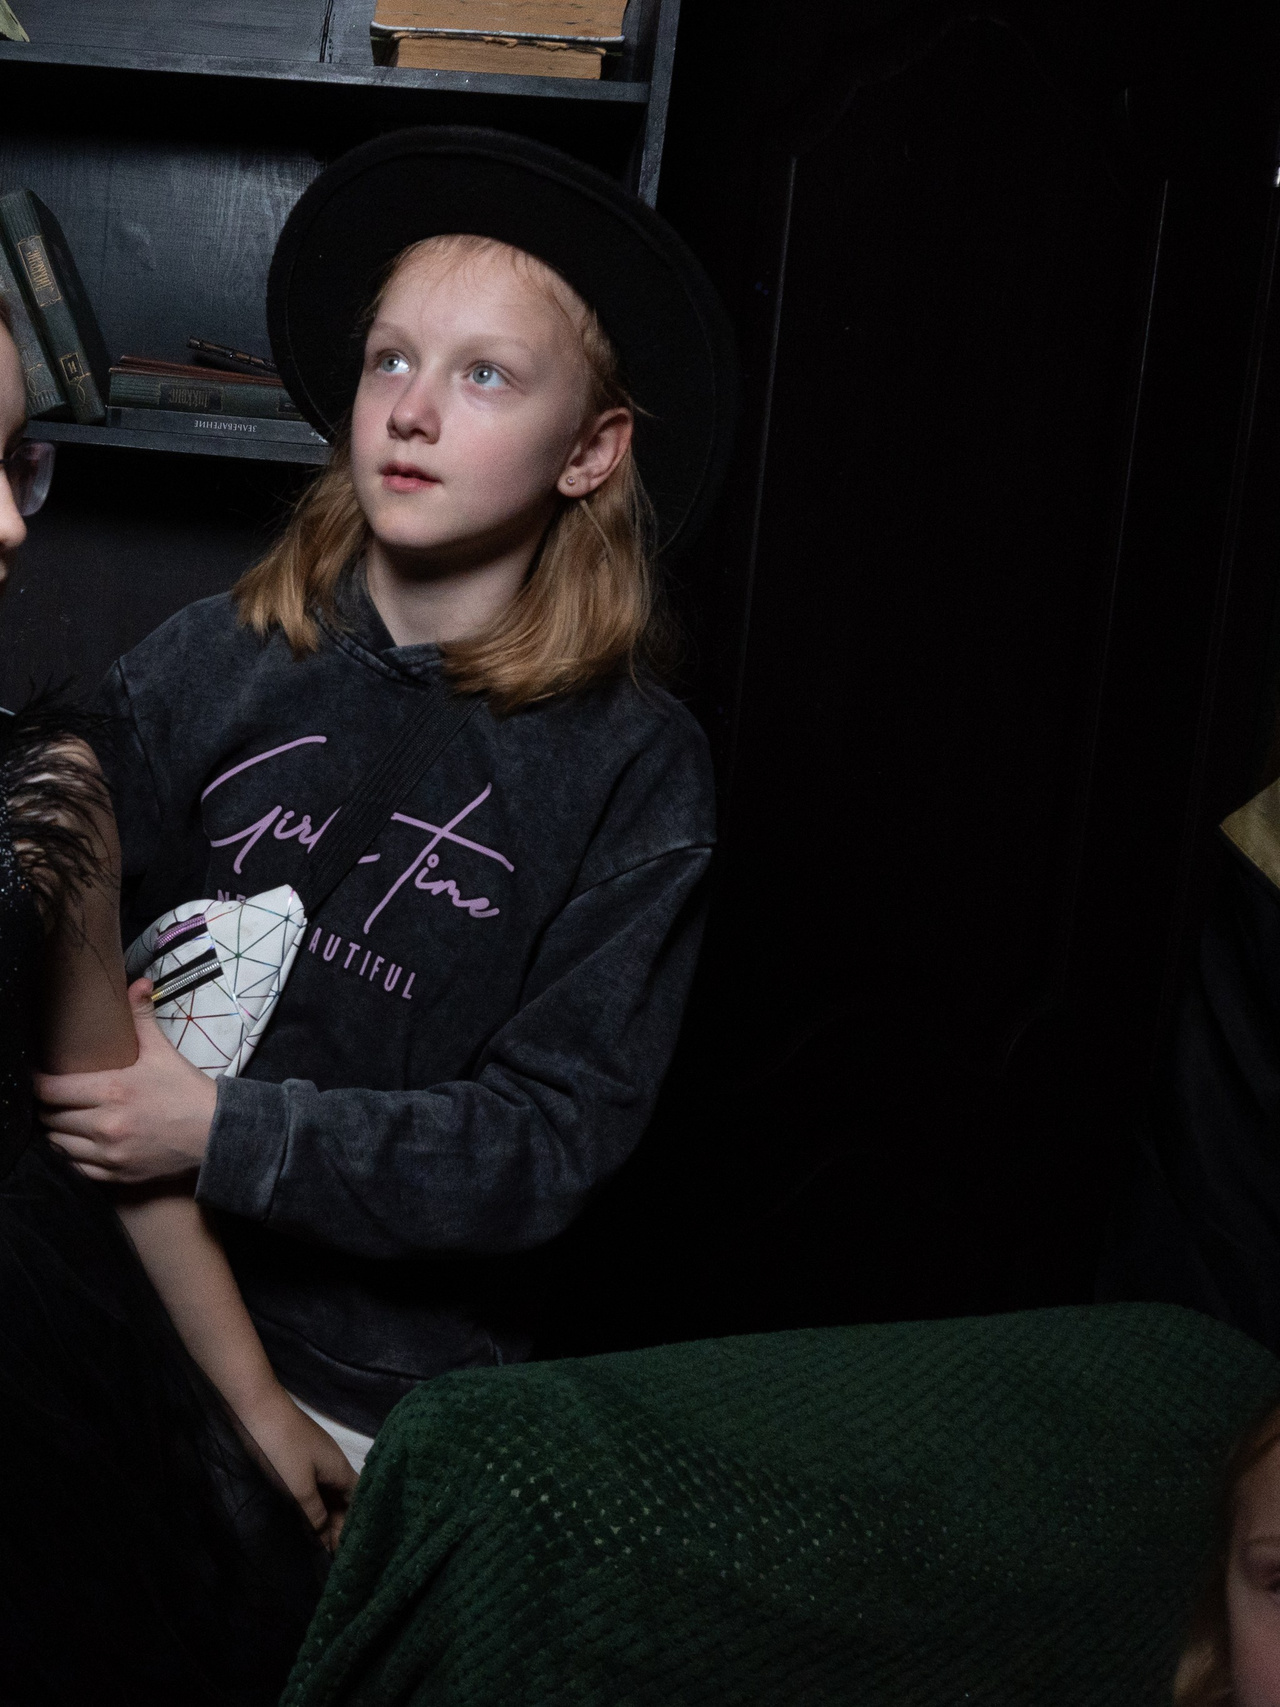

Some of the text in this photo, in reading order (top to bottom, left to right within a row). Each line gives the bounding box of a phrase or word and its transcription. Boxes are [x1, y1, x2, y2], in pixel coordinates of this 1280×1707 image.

[194, 420, 258, 433] ЗЕЛЬЕВАРЕНИЕ
[364, 782, 515, 935] Time
[308, 927, 416, 1000] AUTIFUL
